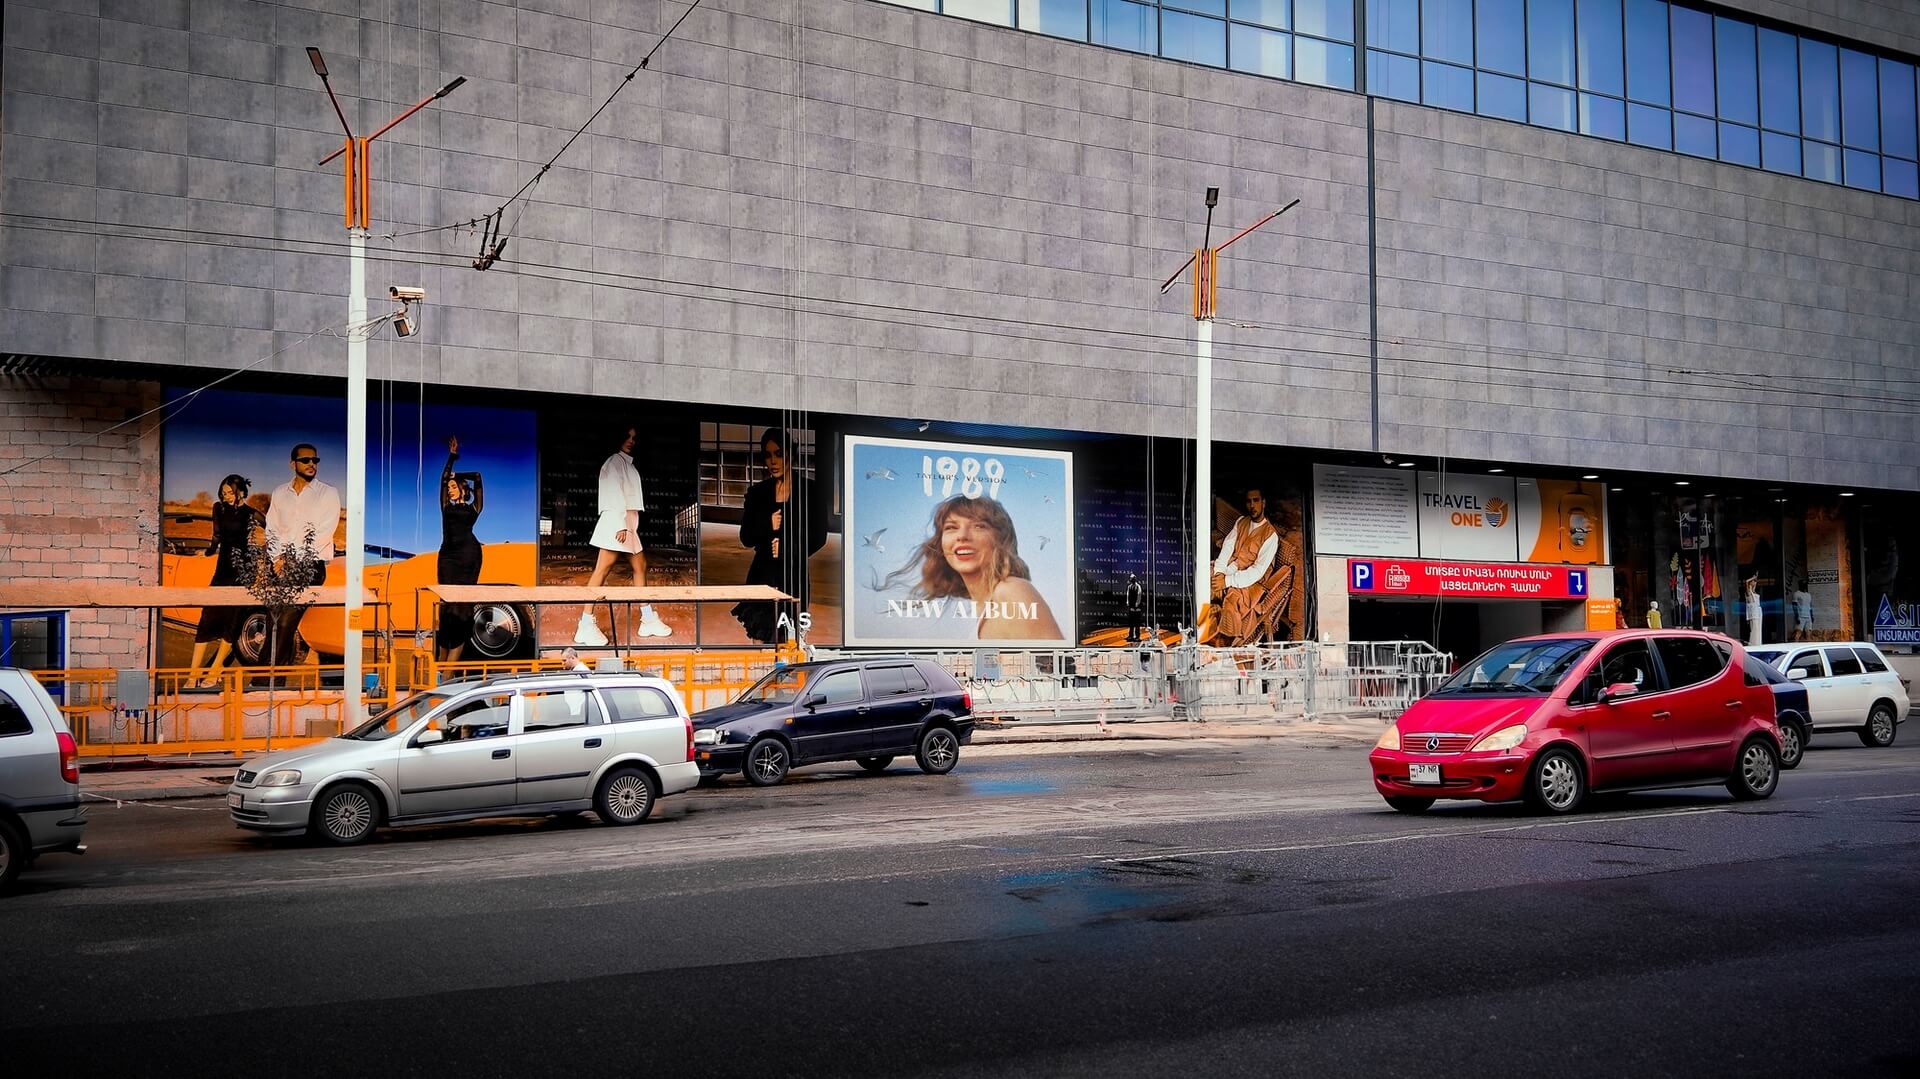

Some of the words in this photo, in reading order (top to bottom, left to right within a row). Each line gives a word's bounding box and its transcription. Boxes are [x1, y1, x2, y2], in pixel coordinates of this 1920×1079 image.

[915, 472, 959, 481] TAYLOR'S
[923, 455, 1005, 500] 1989
[1423, 492, 1482, 510] TRAVEL
[1451, 511, 1482, 528] ONE
[1355, 564, 1370, 588] P
[1425, 566, 1461, 577] ՄՈՒՏՔԸ
[1462, 567, 1495, 578] ՄԻԱՅՆ
[1496, 568, 1527, 579] ՌՈՍԻԱ
[1529, 570, 1553, 581] ՄՈԼԻ
[1441, 580, 1506, 592] ԱՅՑԵԼՈՒՆԵՐԻ
[1510, 583, 1542, 593] ՀԱՄԱՐ
[887, 599, 949, 619] NEW
[952, 600, 1039, 620] ALBUM
[1898, 603, 1920, 626] SI
